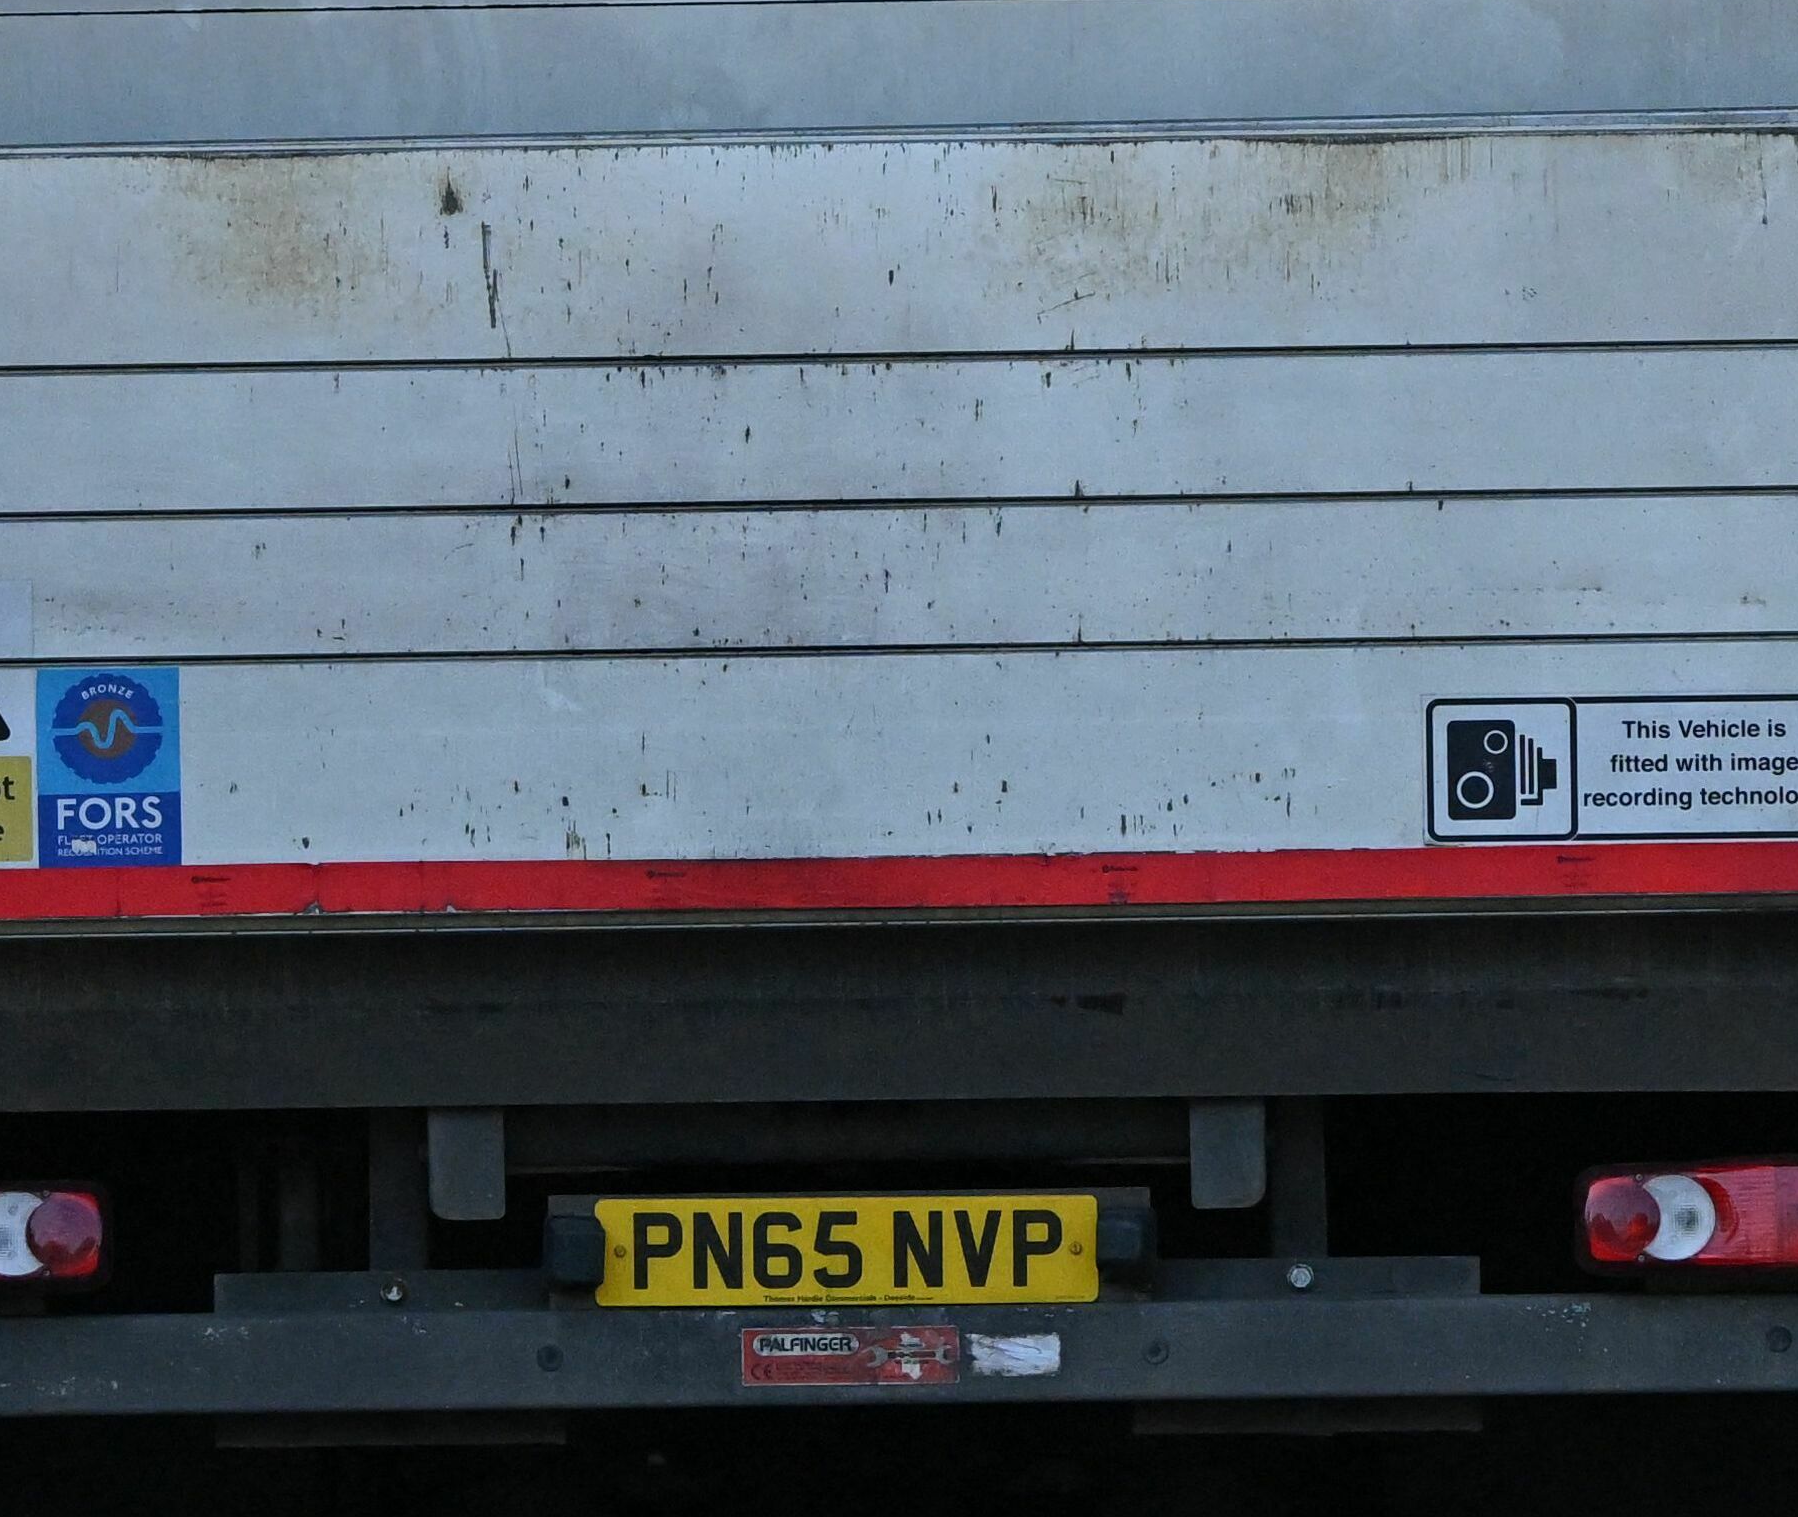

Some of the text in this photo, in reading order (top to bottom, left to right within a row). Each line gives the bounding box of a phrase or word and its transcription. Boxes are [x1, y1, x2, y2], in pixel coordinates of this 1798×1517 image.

[81, 683, 134, 700] BRONZE
[1622, 718, 1787, 739] This Vehicle is
[1610, 753, 1669, 773] fitted
[1675, 753, 1723, 772] with
[1583, 787, 1693, 811] recording
[57, 796, 163, 830] FORS
[97, 833, 163, 845] OPERATOR
[124, 846, 163, 855] SCHEME
[631, 1209, 1063, 1290] PN65 NVP
[759, 1337, 853, 1352] PALFINGER
